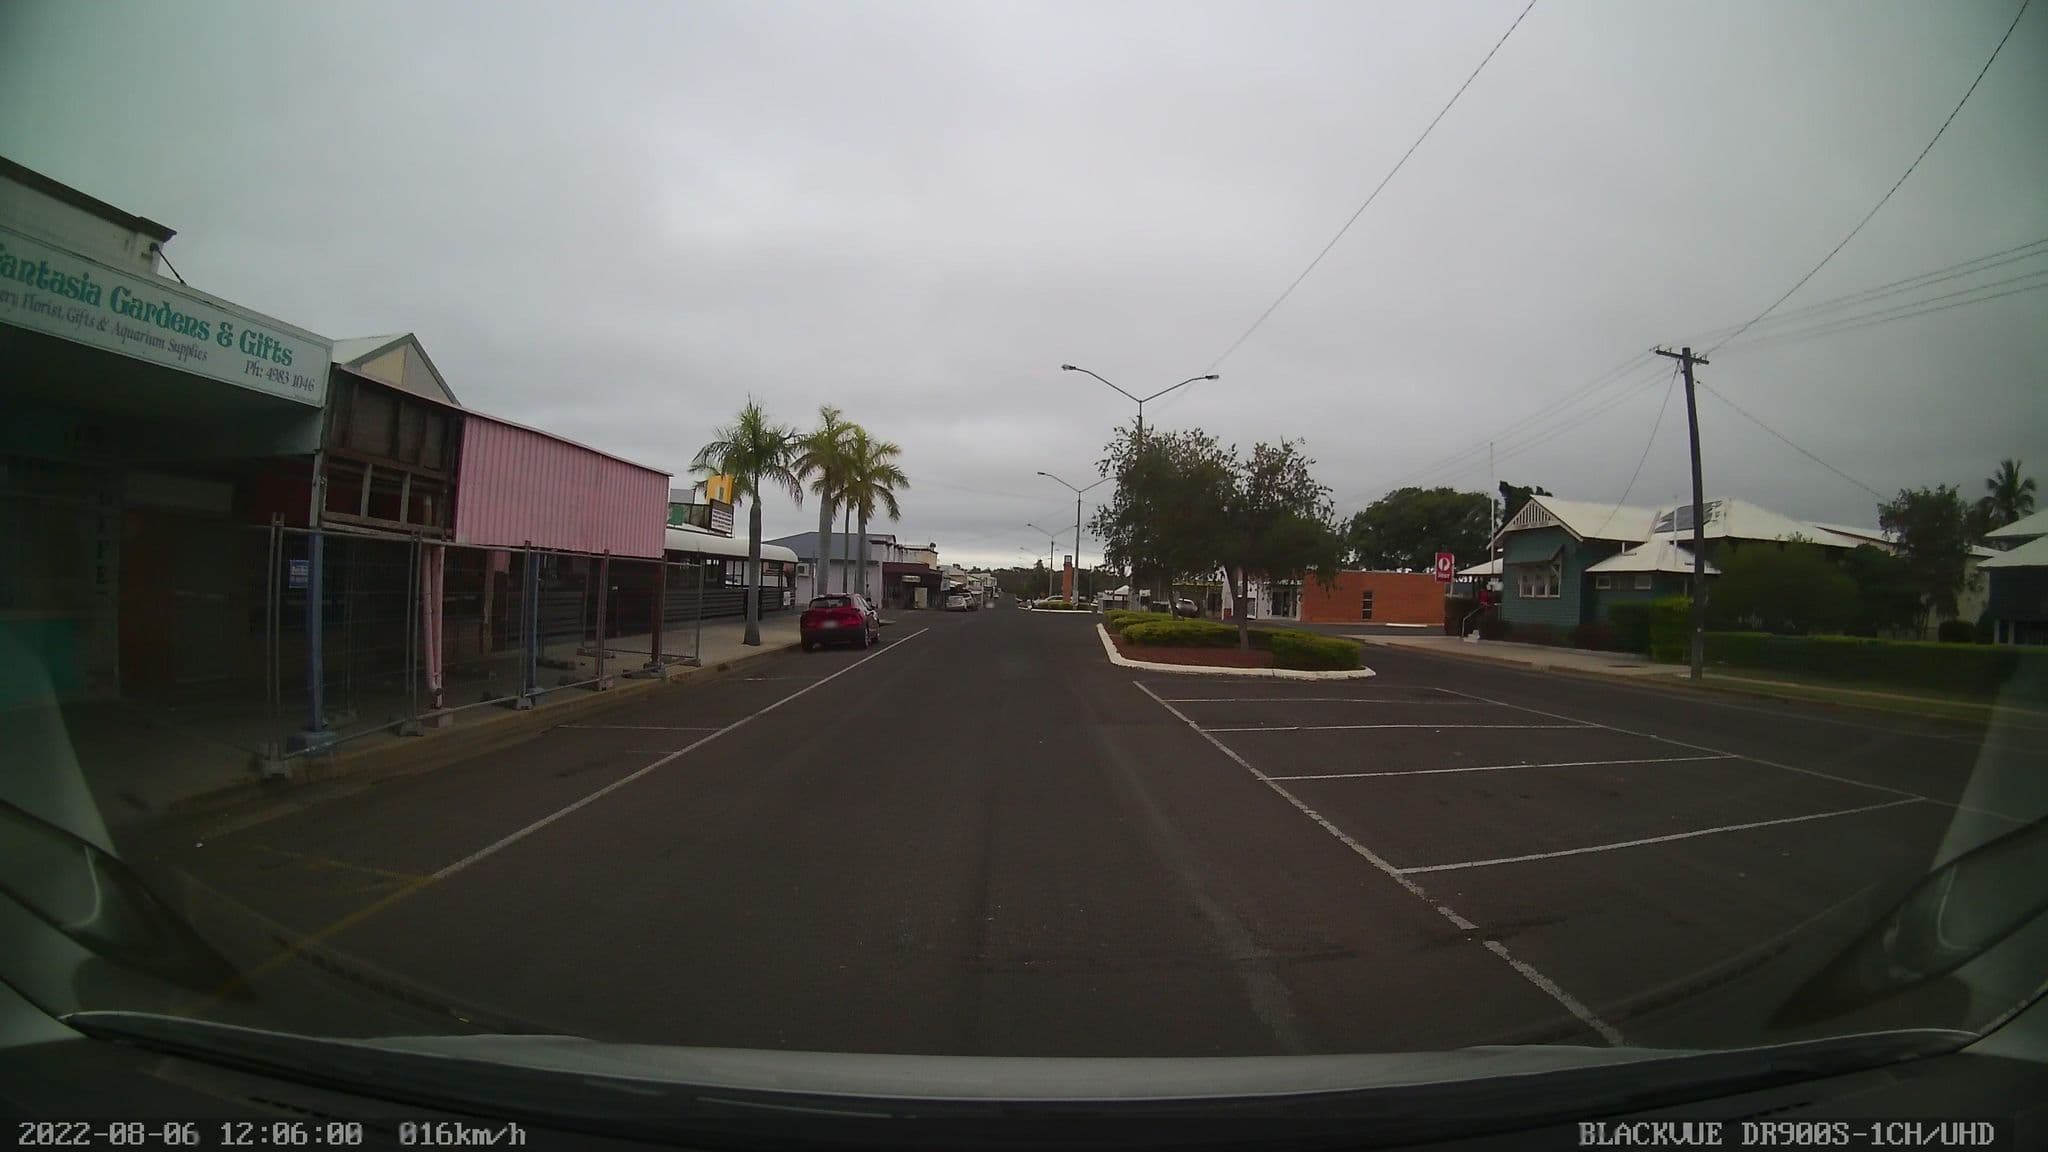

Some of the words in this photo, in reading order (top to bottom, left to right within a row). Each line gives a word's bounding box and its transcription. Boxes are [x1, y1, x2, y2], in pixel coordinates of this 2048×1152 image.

[0, 243, 102, 307] antasia
[110, 285, 211, 341] Gardens
[217, 321, 234, 347] &
[240, 329, 293, 366] Gifts
[66, 307, 95, 328] Gifts
[96, 316, 109, 331] &
[112, 321, 165, 350] Aquarium
[167, 338, 208, 362] Supplies
[244, 359, 263, 378] Ph:
[266, 367, 289, 385] 4983
[291, 374, 315, 392] 1046
